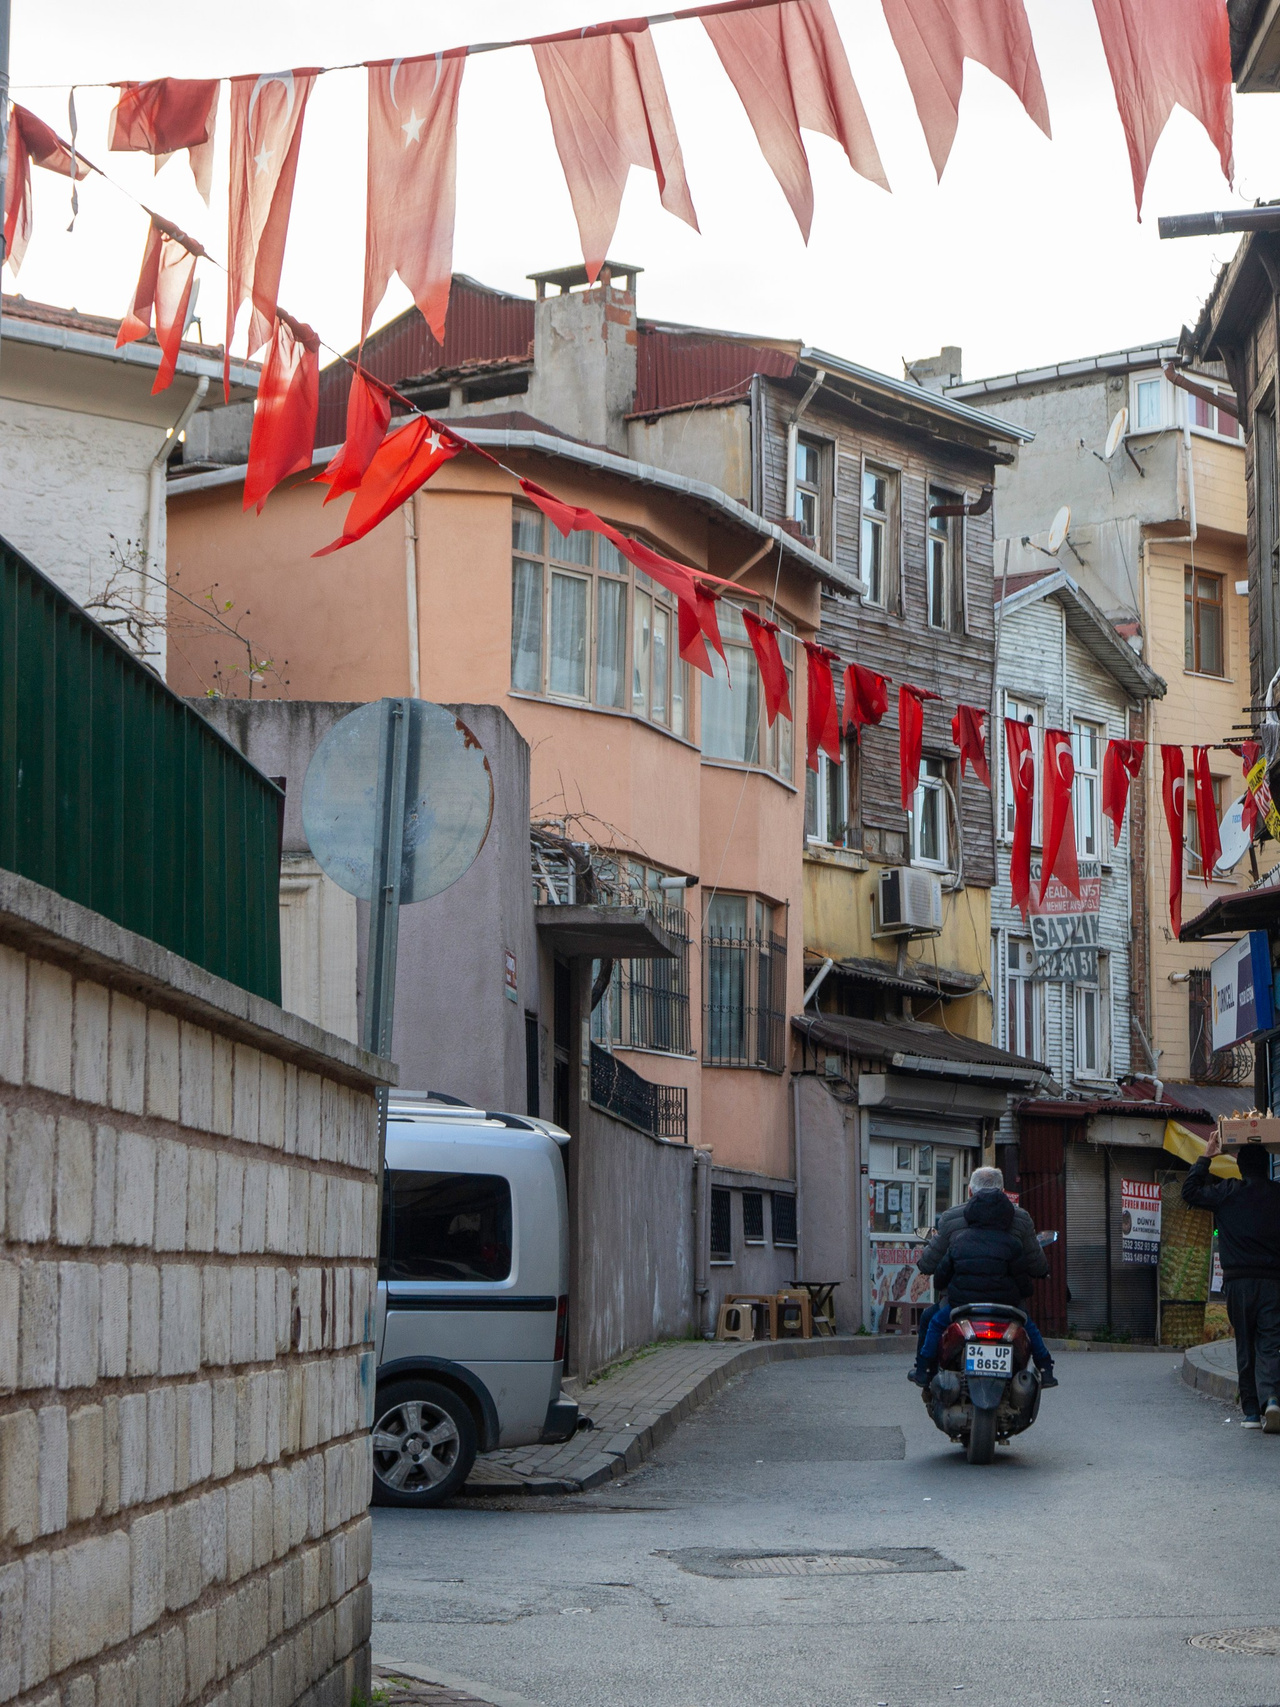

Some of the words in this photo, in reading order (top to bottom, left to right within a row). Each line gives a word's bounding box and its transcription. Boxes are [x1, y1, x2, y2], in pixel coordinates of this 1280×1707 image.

[1122, 1180, 1160, 1198] SATILIK
[969, 1346, 984, 1357] 34
[995, 1347, 1010, 1358] UP
[976, 1359, 1007, 1370] 8652
